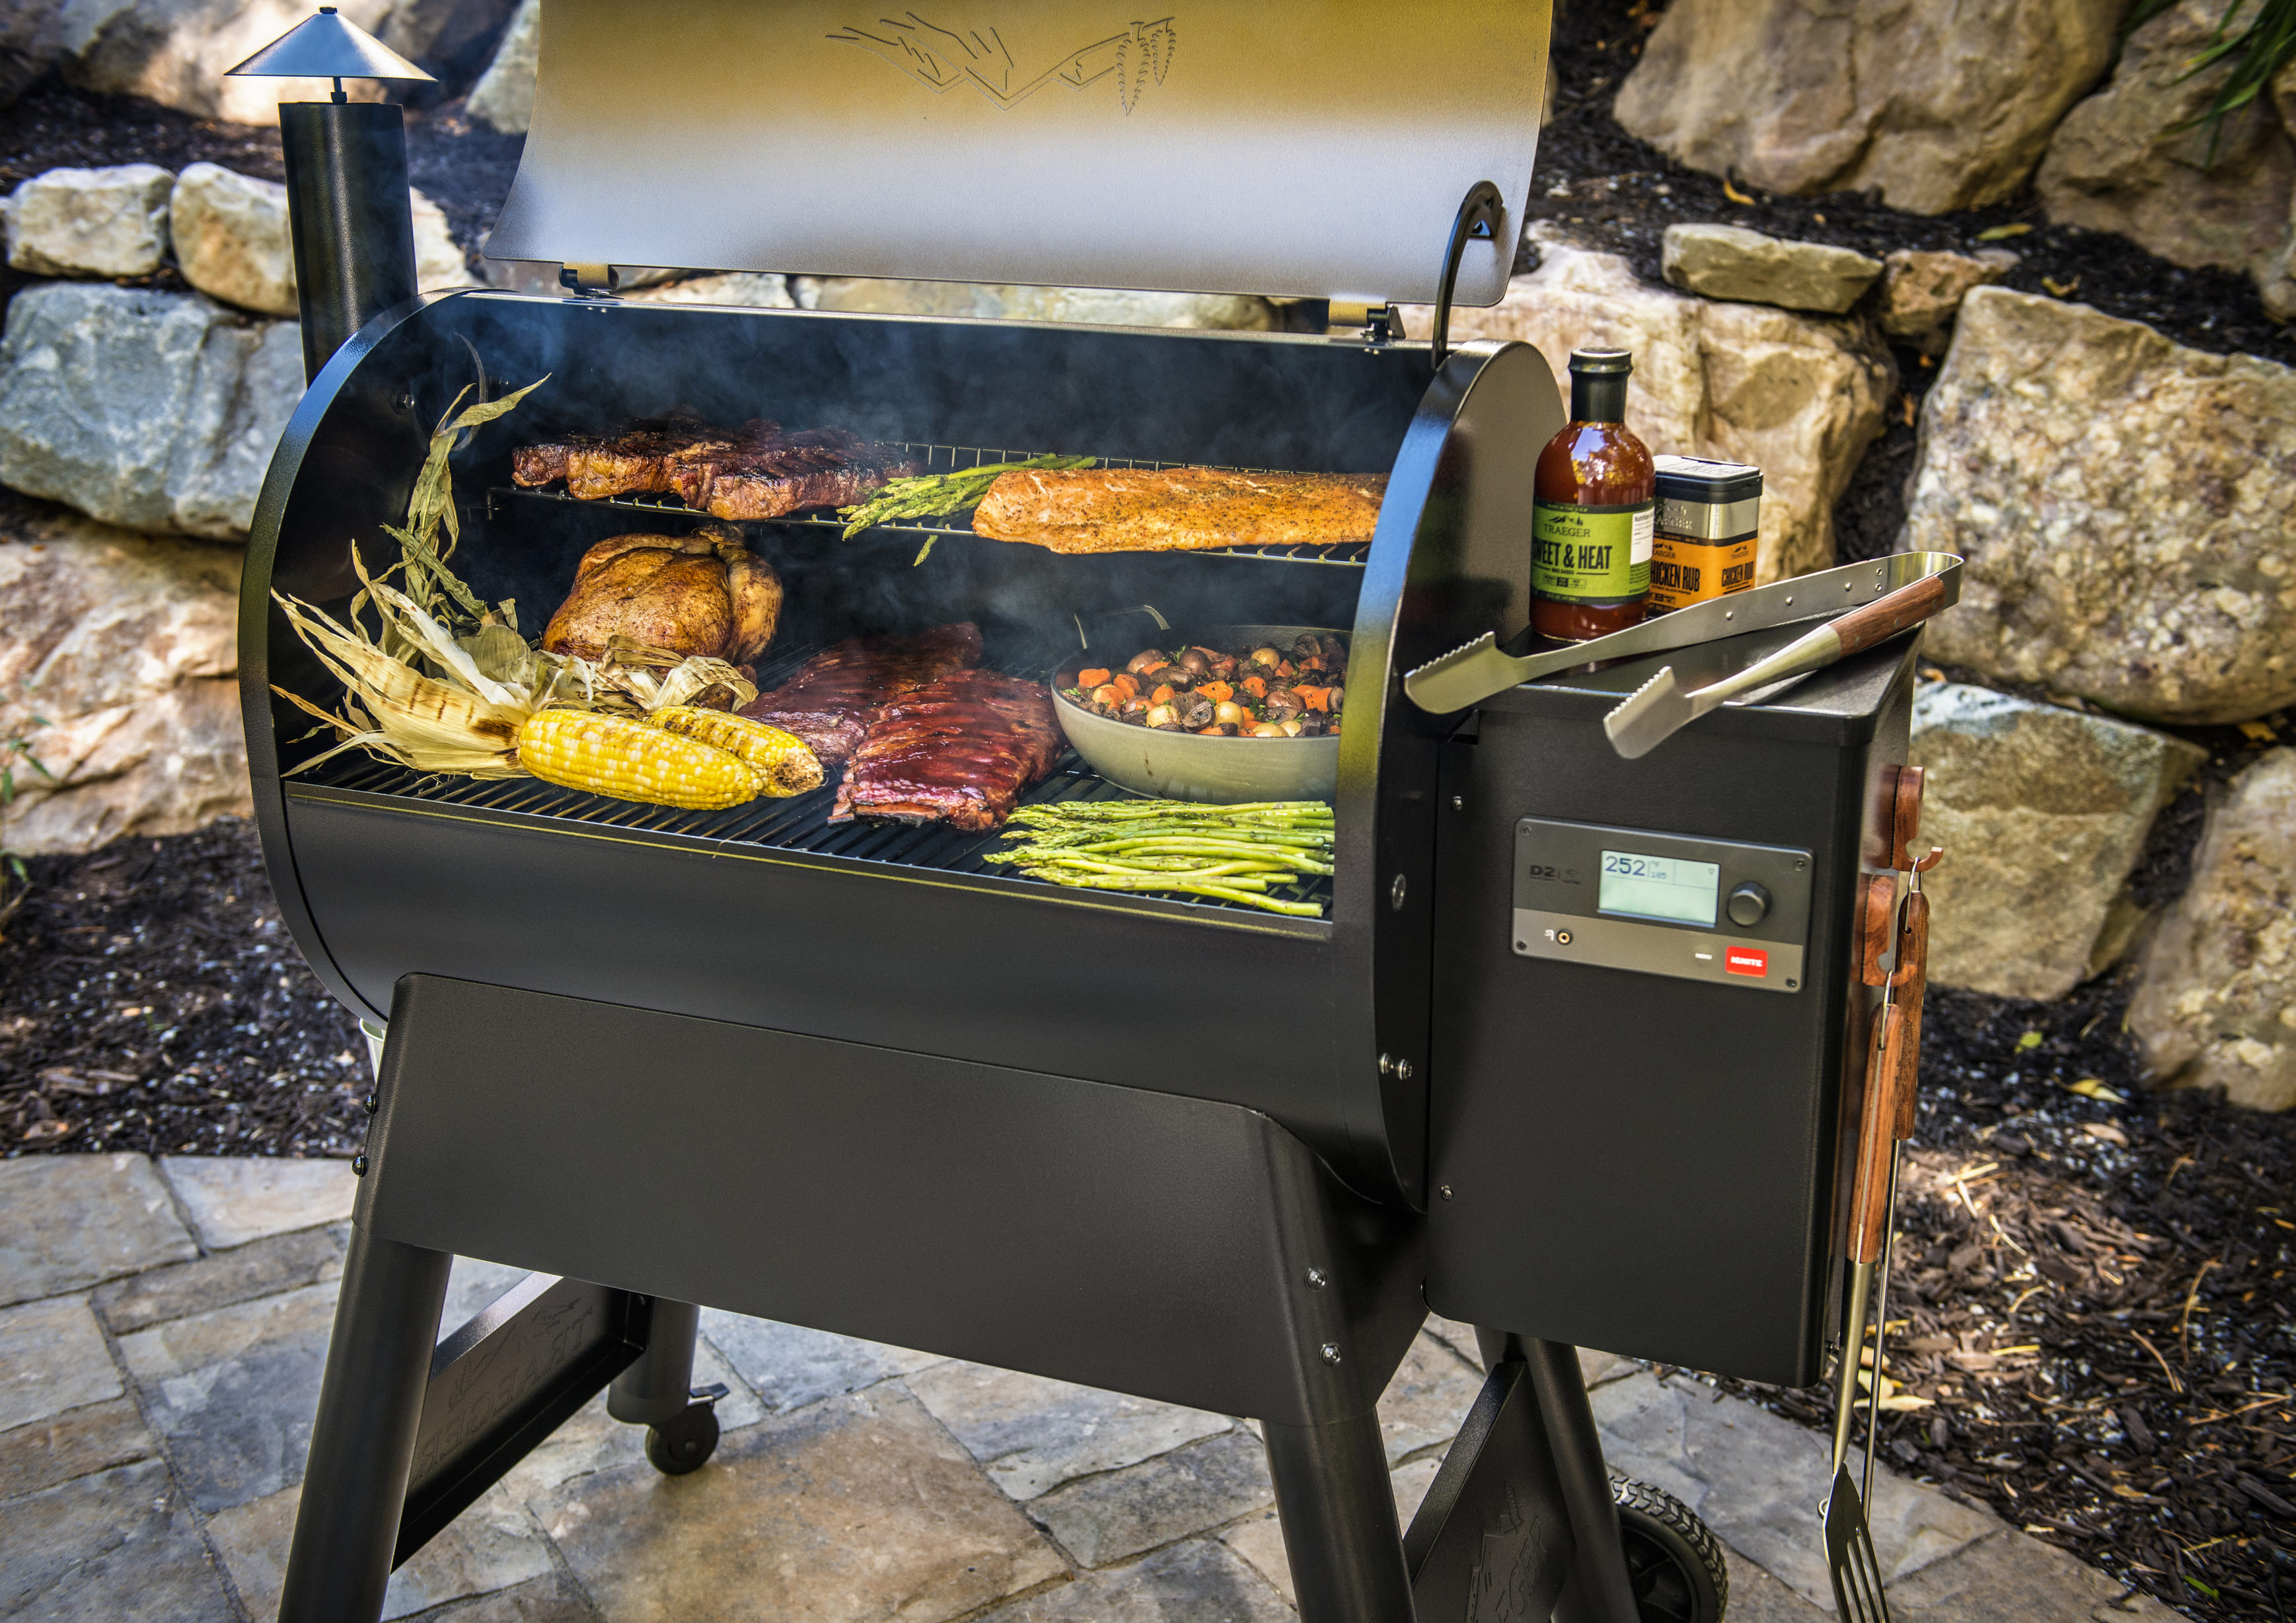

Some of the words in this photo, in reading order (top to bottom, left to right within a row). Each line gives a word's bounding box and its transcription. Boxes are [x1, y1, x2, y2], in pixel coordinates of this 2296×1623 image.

[1544, 523, 1591, 537] TRAEGER
[1563, 544, 1575, 568] &
[1578, 545, 1613, 569] HEAT
[1651, 559, 1682, 588] HICKEN
[1683, 566, 1701, 592] RUB
[1722, 564, 1743, 587] CHICKEN
[1530, 865, 1555, 878] D2
[1605, 856, 1645, 876] 252
[1730, 956, 1763, 967] IGNITE
